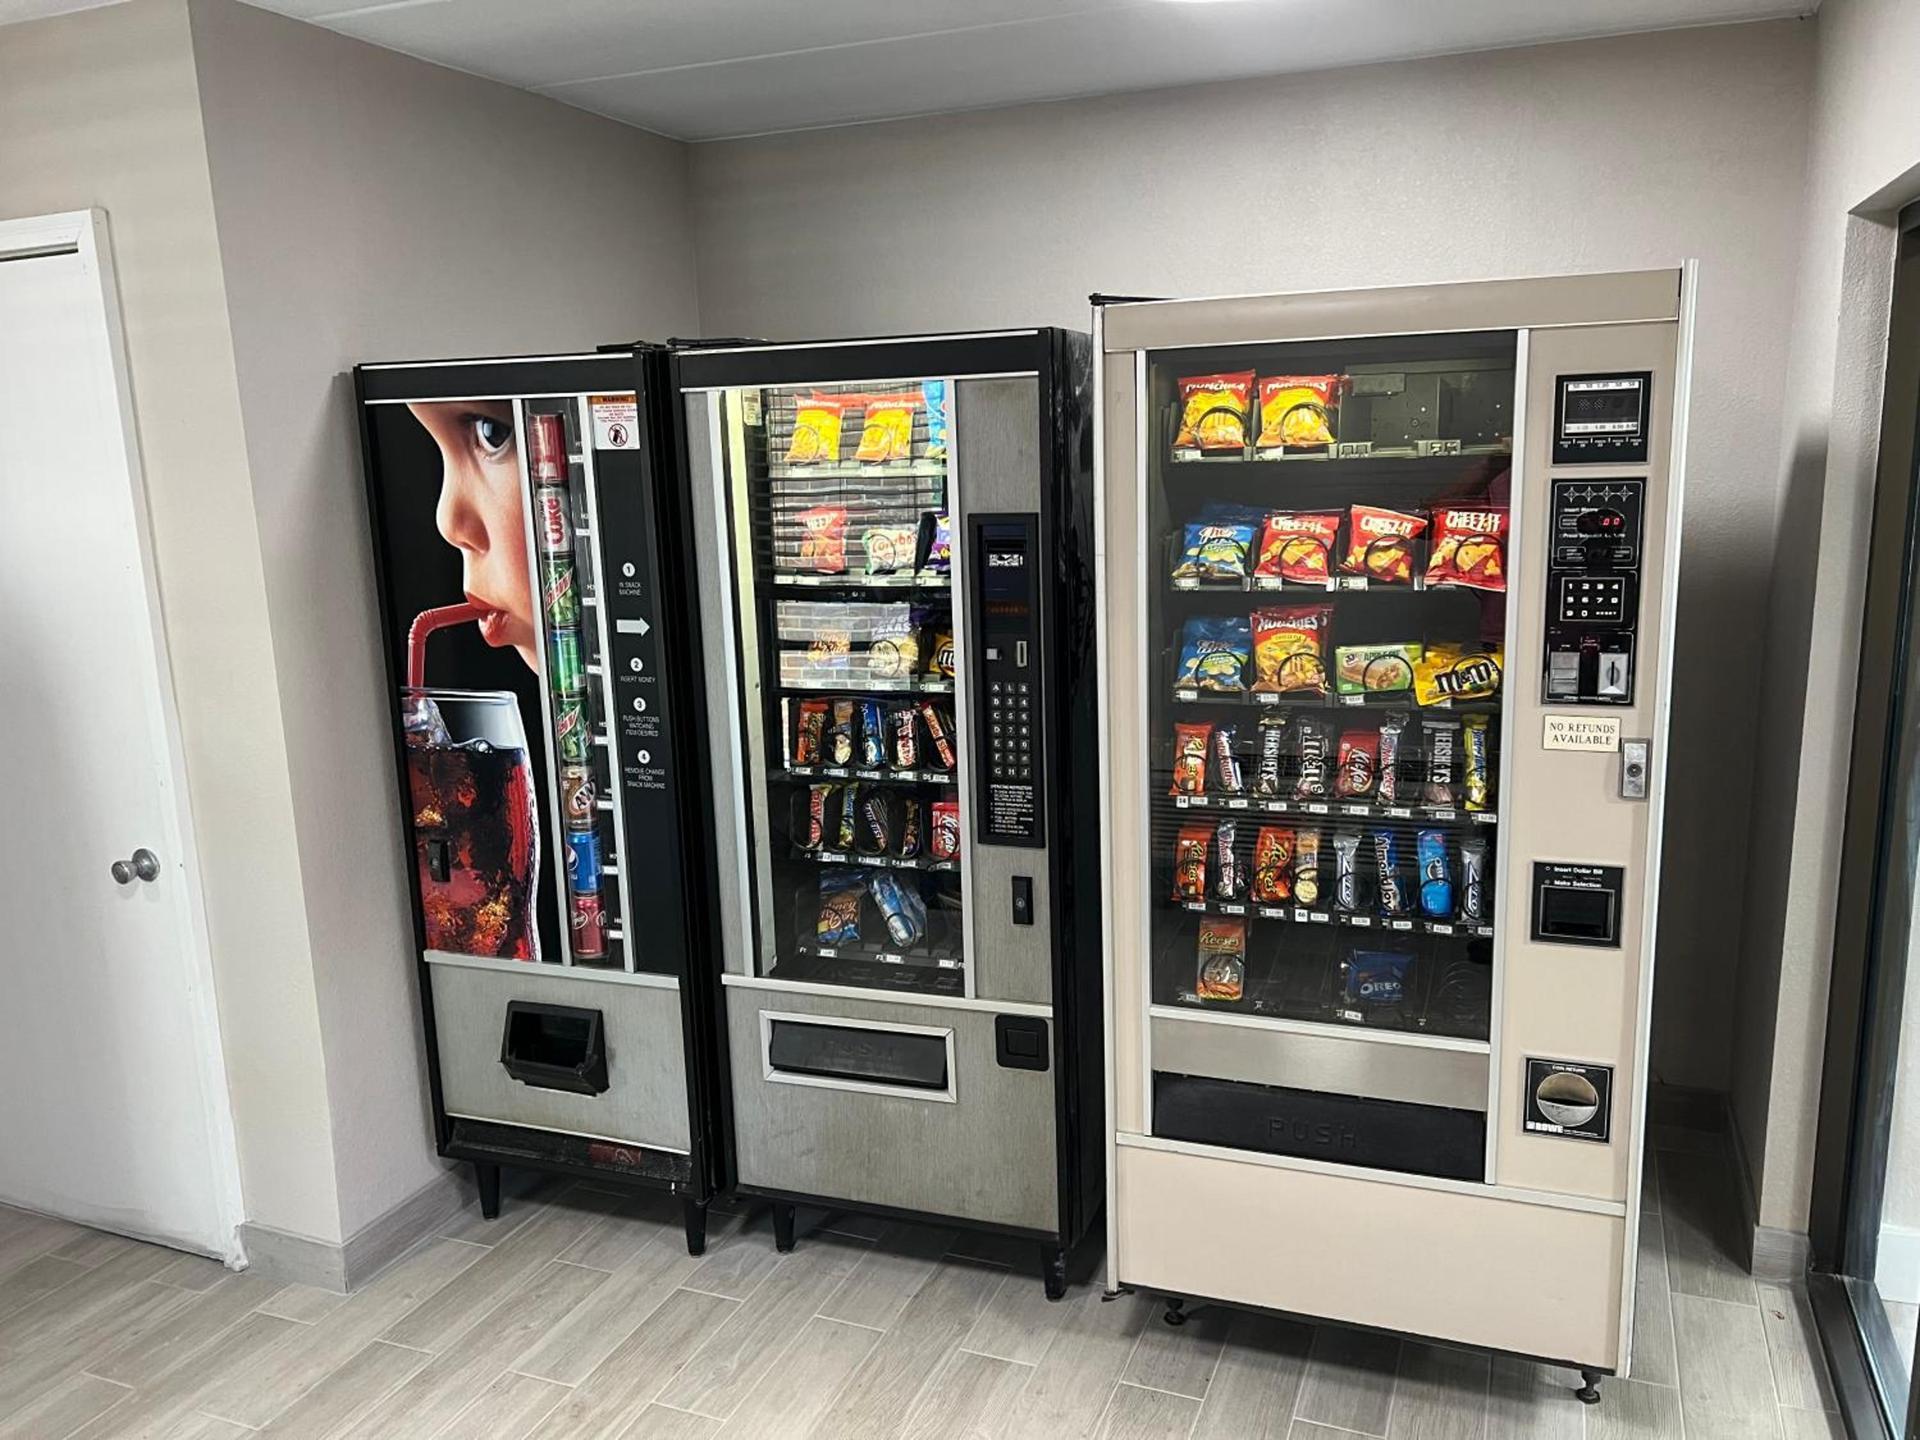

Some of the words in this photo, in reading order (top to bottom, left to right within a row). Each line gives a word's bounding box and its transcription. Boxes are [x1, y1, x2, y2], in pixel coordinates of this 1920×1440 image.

[1256, 616, 1318, 632] MUNCHIES
[1550, 722, 1564, 732] NO
[1568, 722, 1616, 734] REFUNDS
[1552, 734, 1612, 746] AVAILABLE
[1375, 836, 1392, 888] Almond
[1382, 887, 1395, 910] Joy
[1360, 981, 1401, 995] OREO
[1267, 1115, 1358, 1148] PUSH
[1535, 1122, 1564, 1134] ROWE
